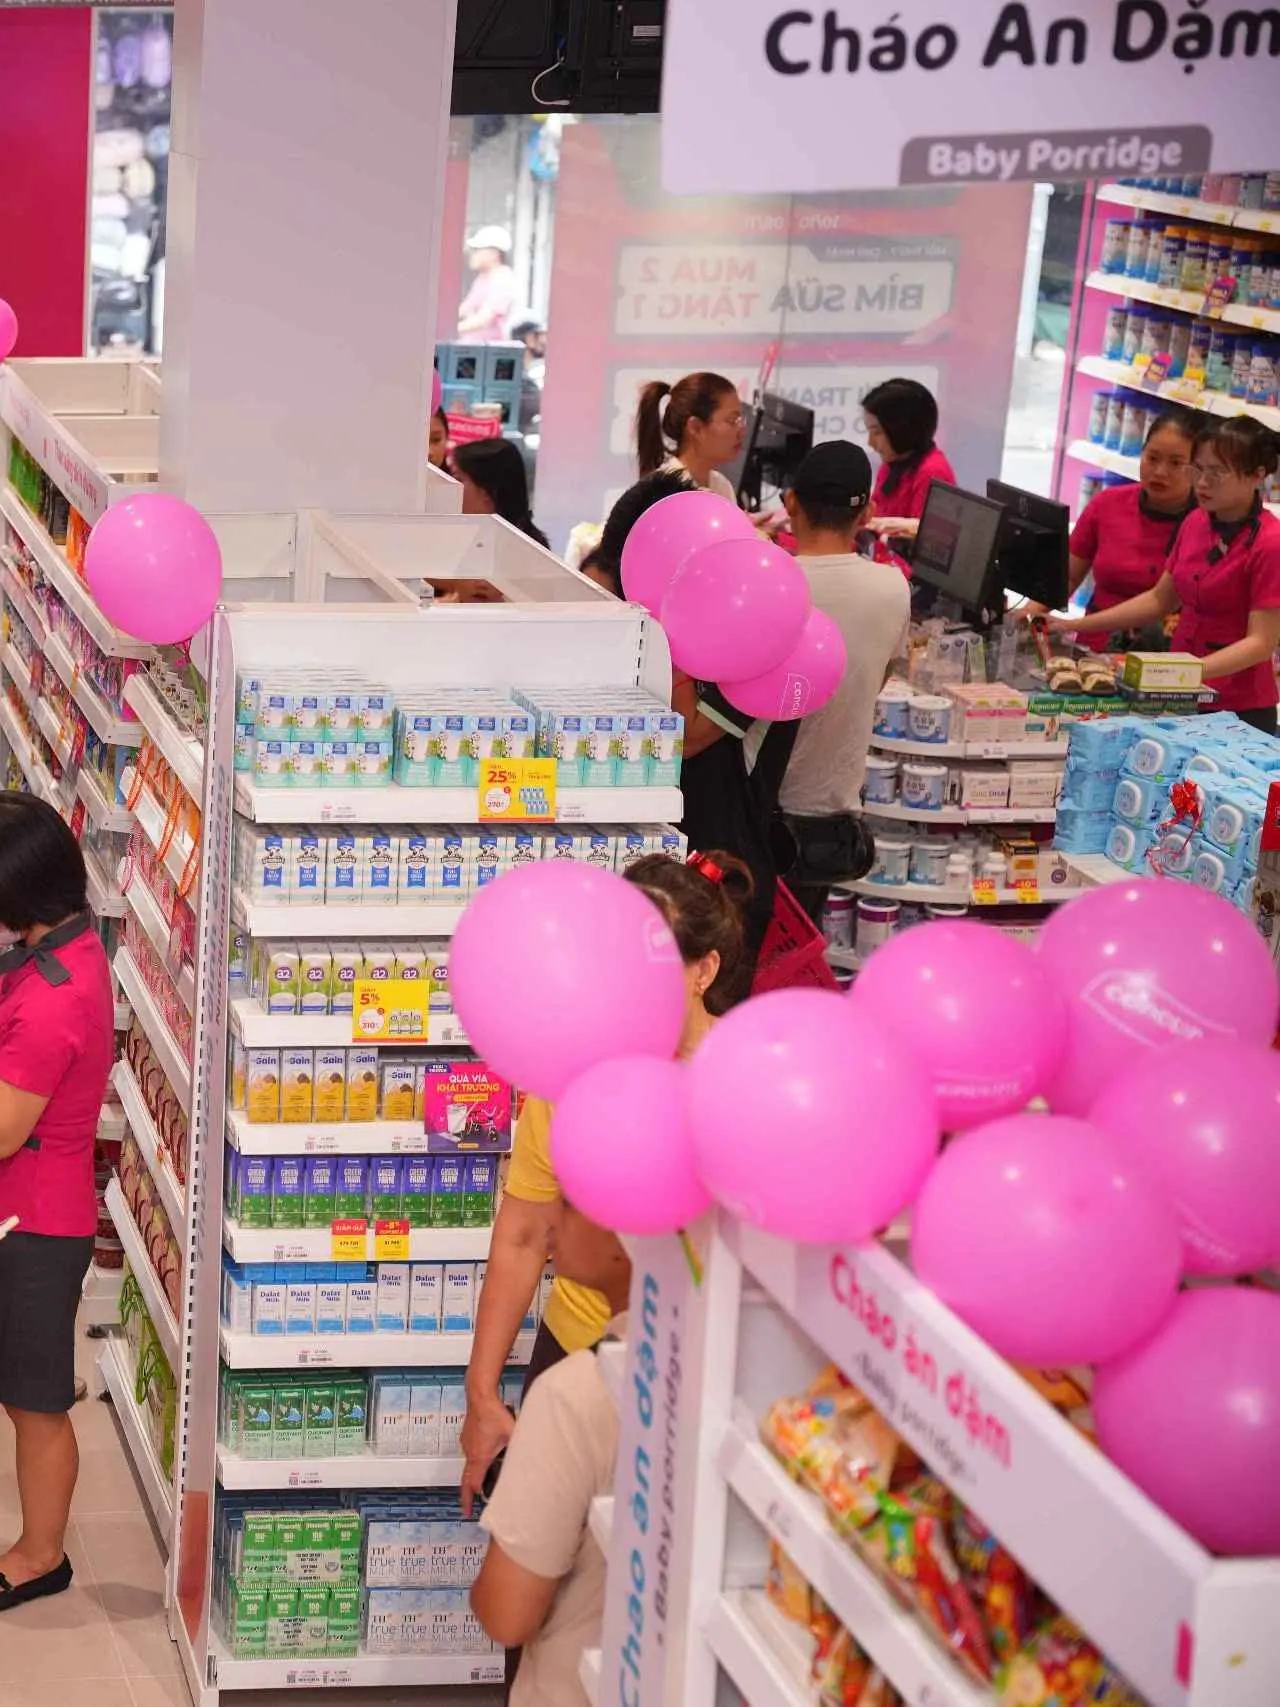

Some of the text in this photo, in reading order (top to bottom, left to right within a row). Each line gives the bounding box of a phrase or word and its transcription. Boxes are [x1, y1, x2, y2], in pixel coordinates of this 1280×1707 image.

[764, 10, 958, 75] Cháo
[928, 137, 1183, 180] Baby Porridge
[487, 770, 517, 783] 25%
[275, 969, 291, 979] a2
[308, 969, 324, 980] a2
[339, 969, 355, 979] a2
[371, 969, 387, 979] a2
[402, 969, 418, 979] a2
[433, 968, 449, 978] a2
[359, 993, 381, 1005] 5%
[256, 1056, 277, 1065] Gain
[289, 1056, 310, 1065] Gain
[322, 1056, 343, 1065] Gain
[355, 1055, 376, 1064] Gain
[391, 1071, 412, 1080] Gain
[381, 1274, 402, 1282] Dalat
[415, 1275, 436, 1283] Dalat
[448, 1274, 468, 1282] Dalat
[290, 1290, 311, 1298] Dalat
[351, 1289, 371, 1297] Dalat
[830, 1252, 897, 1351] Cháo
[946, 1370, 1012, 1469] dặm
[654, 1332, 682, 1621] Baby porridge
[370, 1556, 396, 1567] true
[400, 1556, 426, 1566] true
[430, 1555, 457, 1566] true
[370, 1623, 397, 1634] true
[401, 1623, 427, 1634] true
[431, 1623, 458, 1634] true
